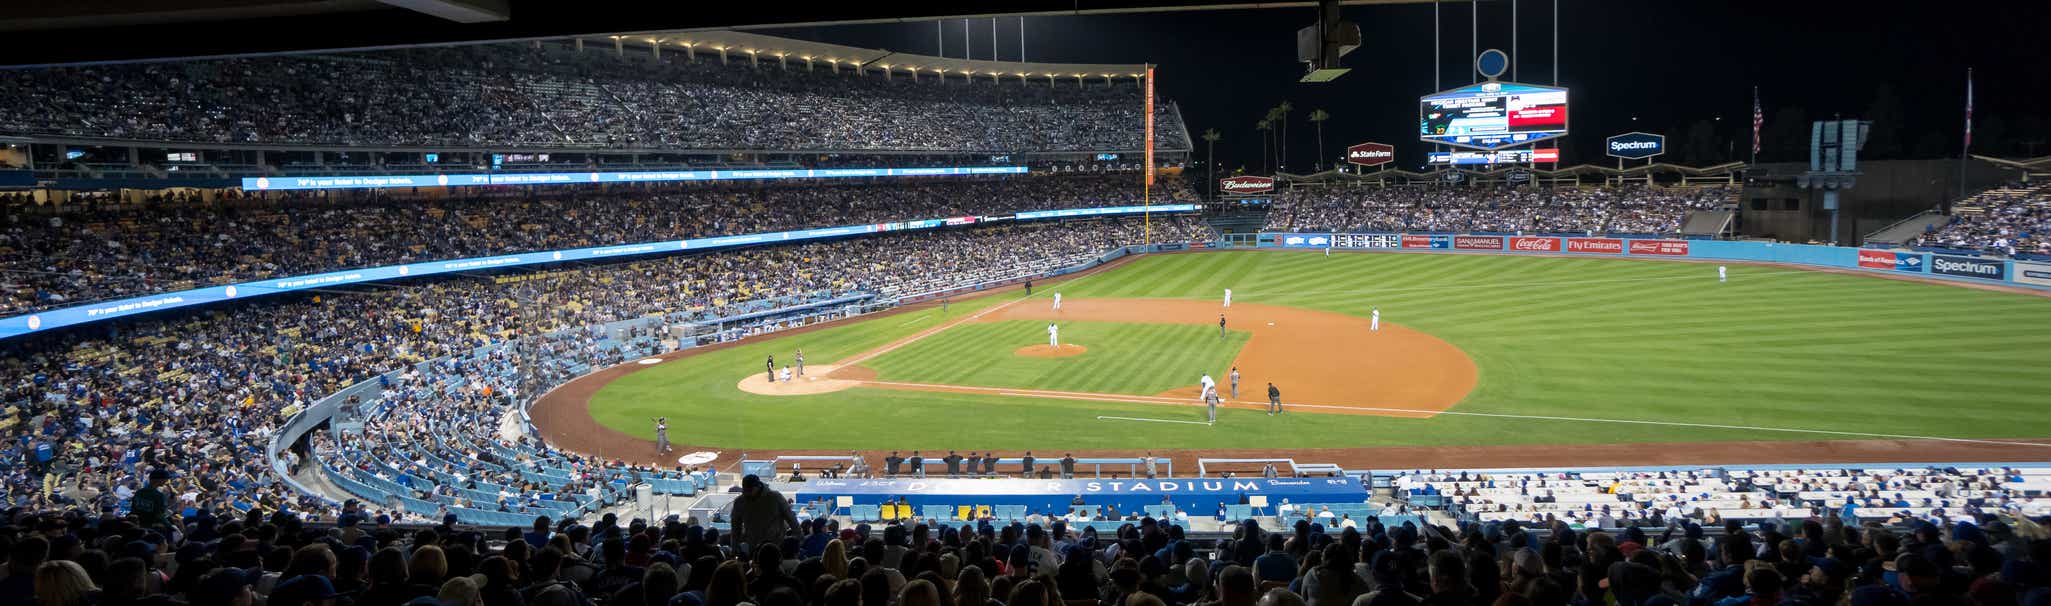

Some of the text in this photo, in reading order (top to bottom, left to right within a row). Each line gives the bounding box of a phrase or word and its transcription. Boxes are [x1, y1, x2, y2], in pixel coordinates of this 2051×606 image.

[1611, 141, 1656, 151] Spectrum
[1223, 180, 1271, 190] Budweiser
[1568, 241, 1621, 250] Fly Emirates
[1935, 259, 1996, 275] Spectrum
[1087, 481, 1259, 491] STADIUM
